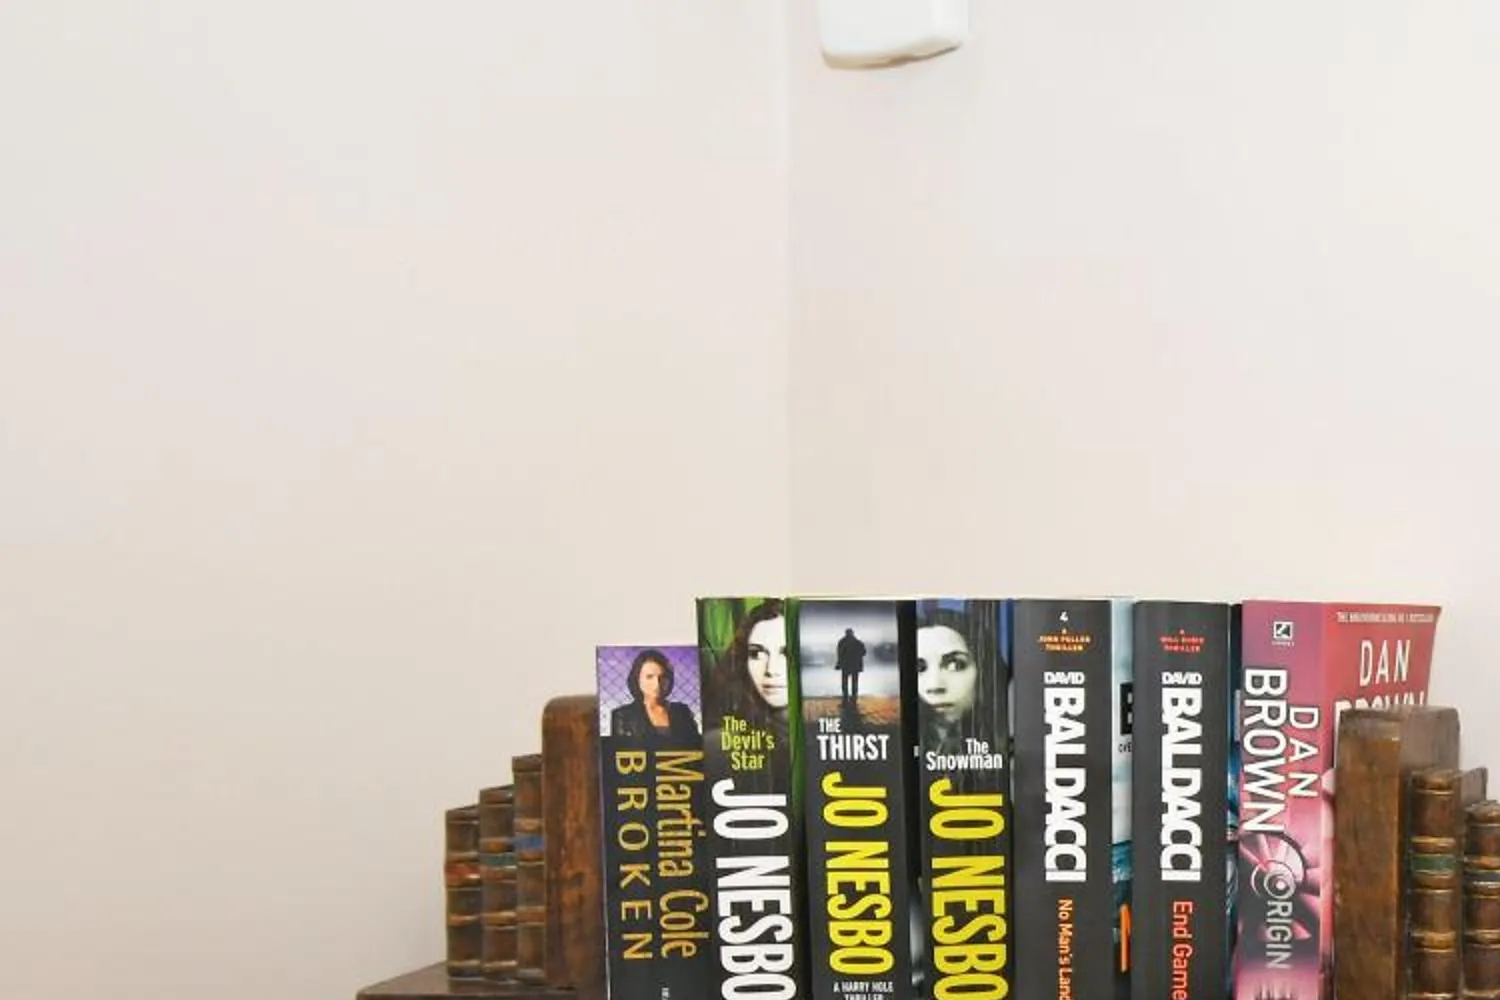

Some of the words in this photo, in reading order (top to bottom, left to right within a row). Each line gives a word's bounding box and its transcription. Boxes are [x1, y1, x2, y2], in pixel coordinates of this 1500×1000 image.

[1043, 671, 1085, 685] DAVID
[1161, 671, 1203, 685] DAVID
[1359, 639, 1411, 687] DAN
[721, 731, 775, 750] Devil's
[723, 716, 747, 732] The
[817, 735, 890, 761] THIRST
[818, 718, 841, 733] THE
[965, 738, 989, 754] The
[731, 751, 765, 771] Star
[925, 751, 1003, 771] Snowman
[1241, 668, 1287, 834] BROWN
[1288, 705, 1320, 800] DAN
[711, 777, 789, 840] JO
[821, 772, 889, 828] JO
[1043, 687, 1087, 882] BALDACCI
[1160, 687, 1203, 882] BALDACCI
[655, 751, 706, 878] Martina
[928, 777, 1006, 841] JO
[615, 750, 653, 961] BROKEN
[659, 890, 709, 960] Cole
[825, 841, 896, 976] NESBO
[1057, 899, 1073, 920] No
[1171, 900, 1193, 944] End
[1264, 868, 1296, 969] ORIGIN
[833, 982, 840, 992] A
[841, 982, 869, 992] HARRY
[871, 981, 894, 992] HOLE
